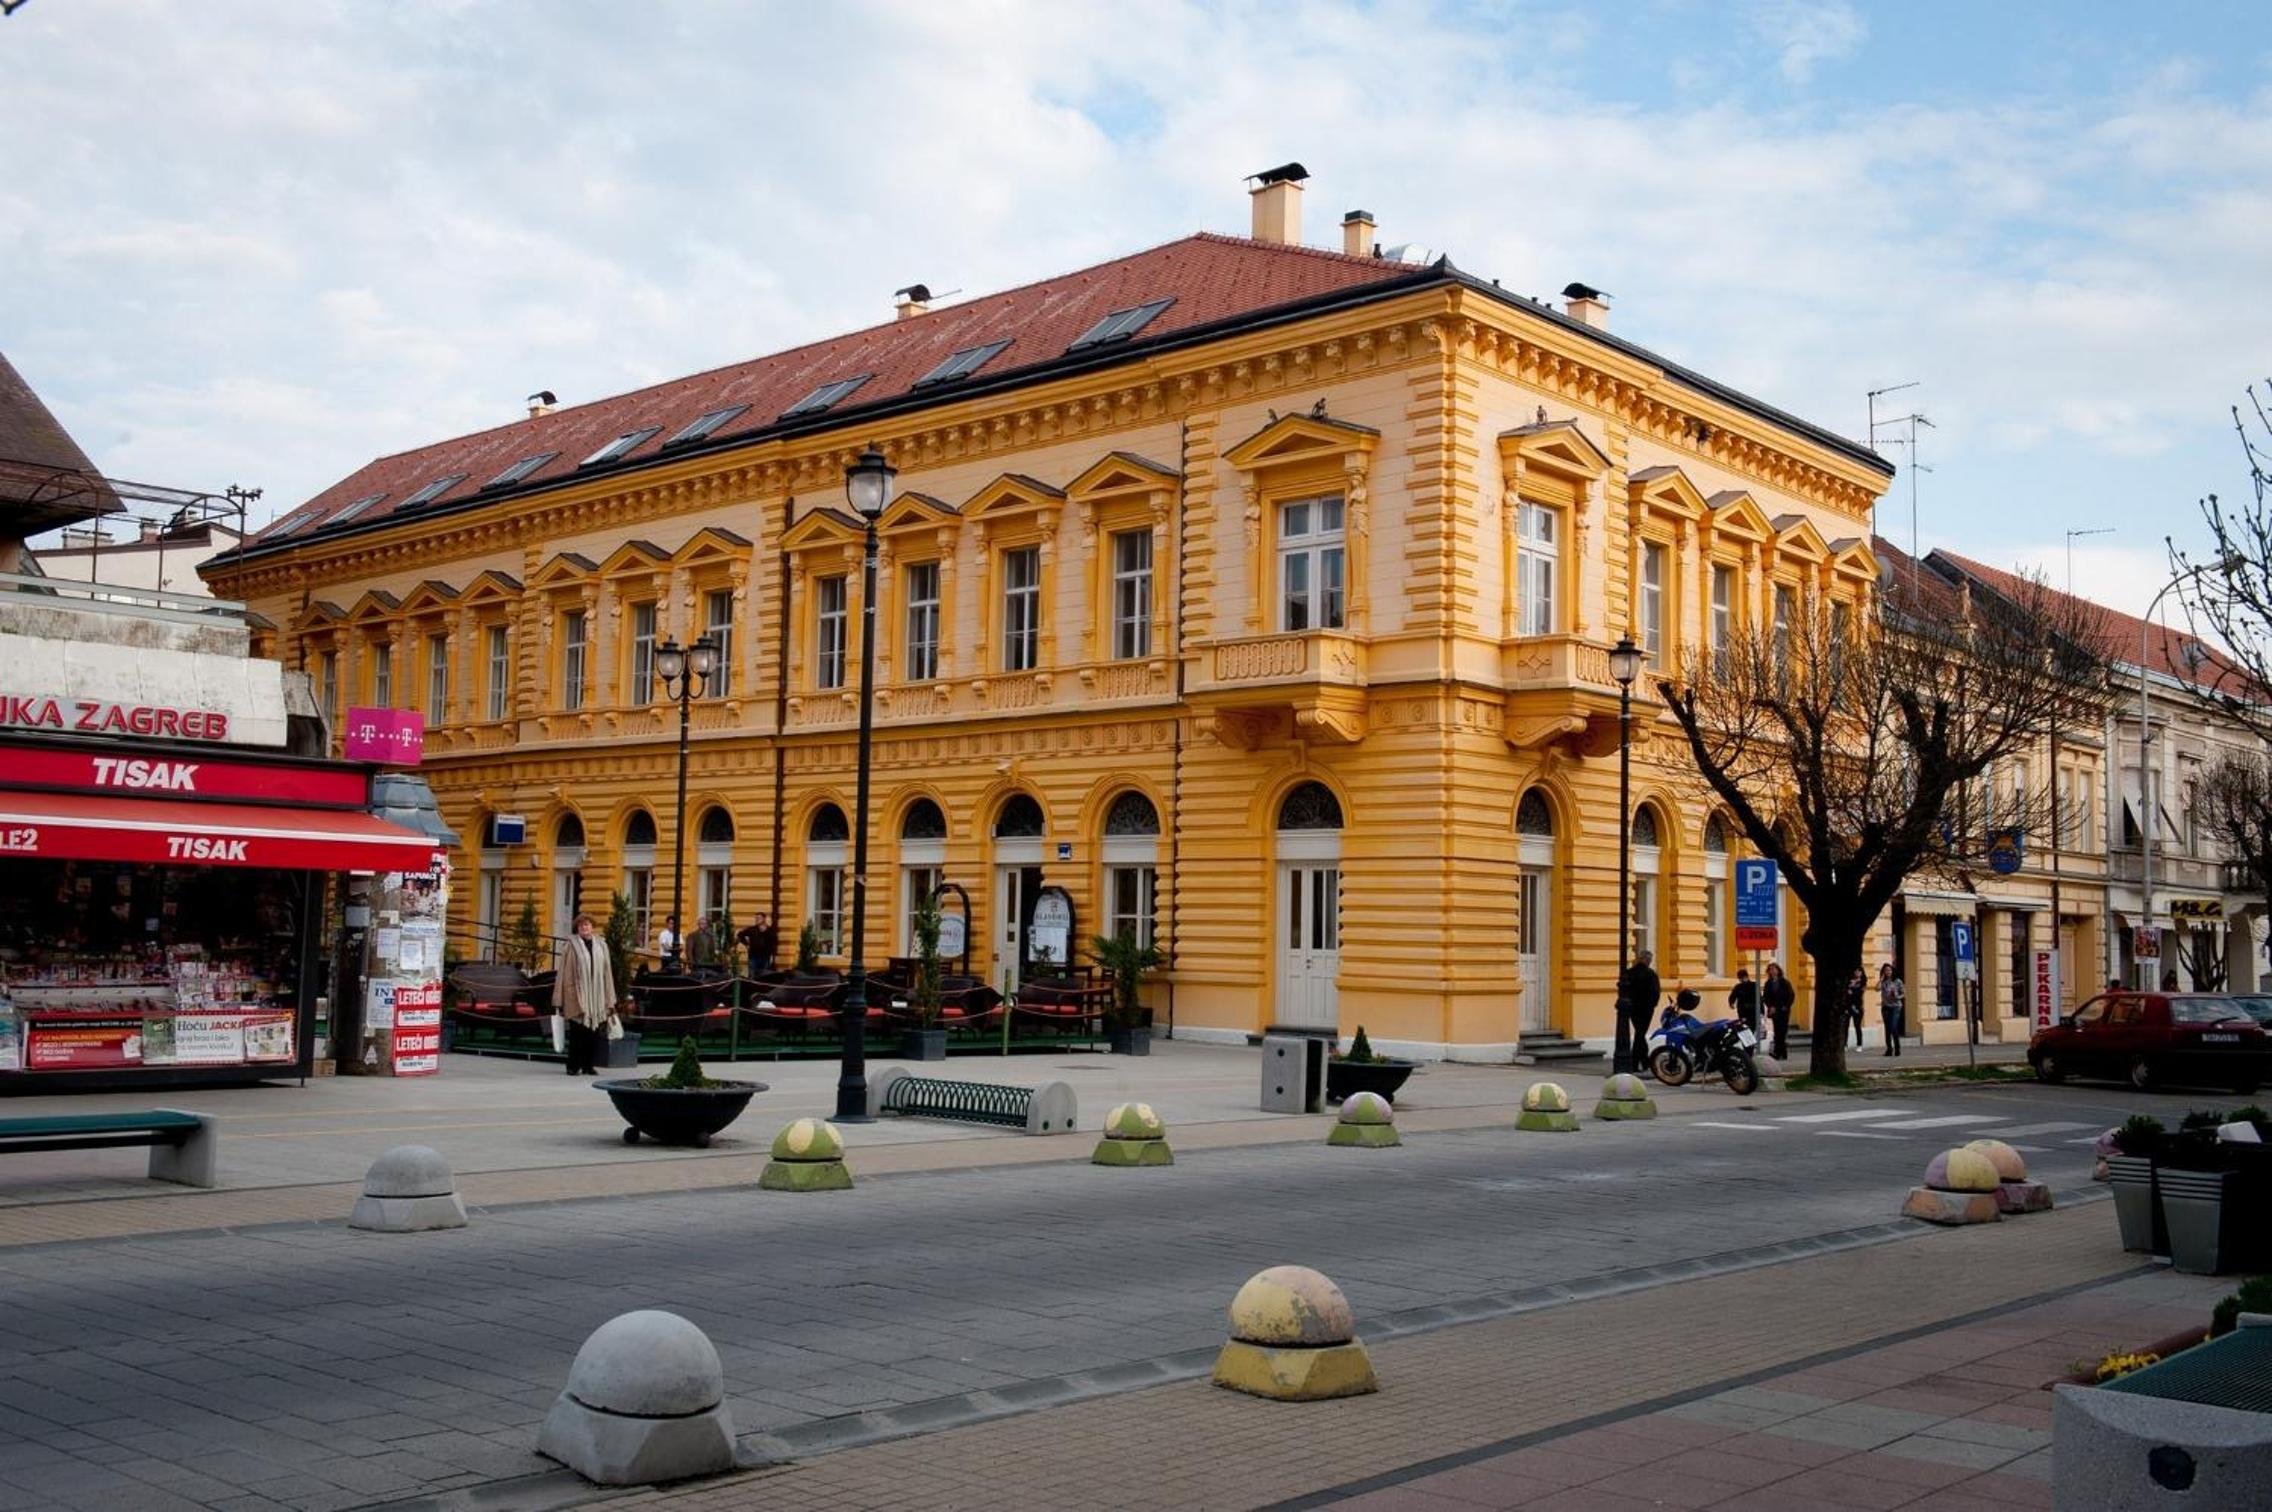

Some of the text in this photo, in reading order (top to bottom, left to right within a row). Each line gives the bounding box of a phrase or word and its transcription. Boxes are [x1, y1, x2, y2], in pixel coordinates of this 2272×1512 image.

[75, 702, 229, 740] ZAGREB
[93, 757, 199, 791] TISAK
[167, 836, 249, 861] TISAK
[1746, 866, 1767, 894] P
[1956, 928, 1968, 956] P
[2037, 952, 2051, 1025] PEKARNA
